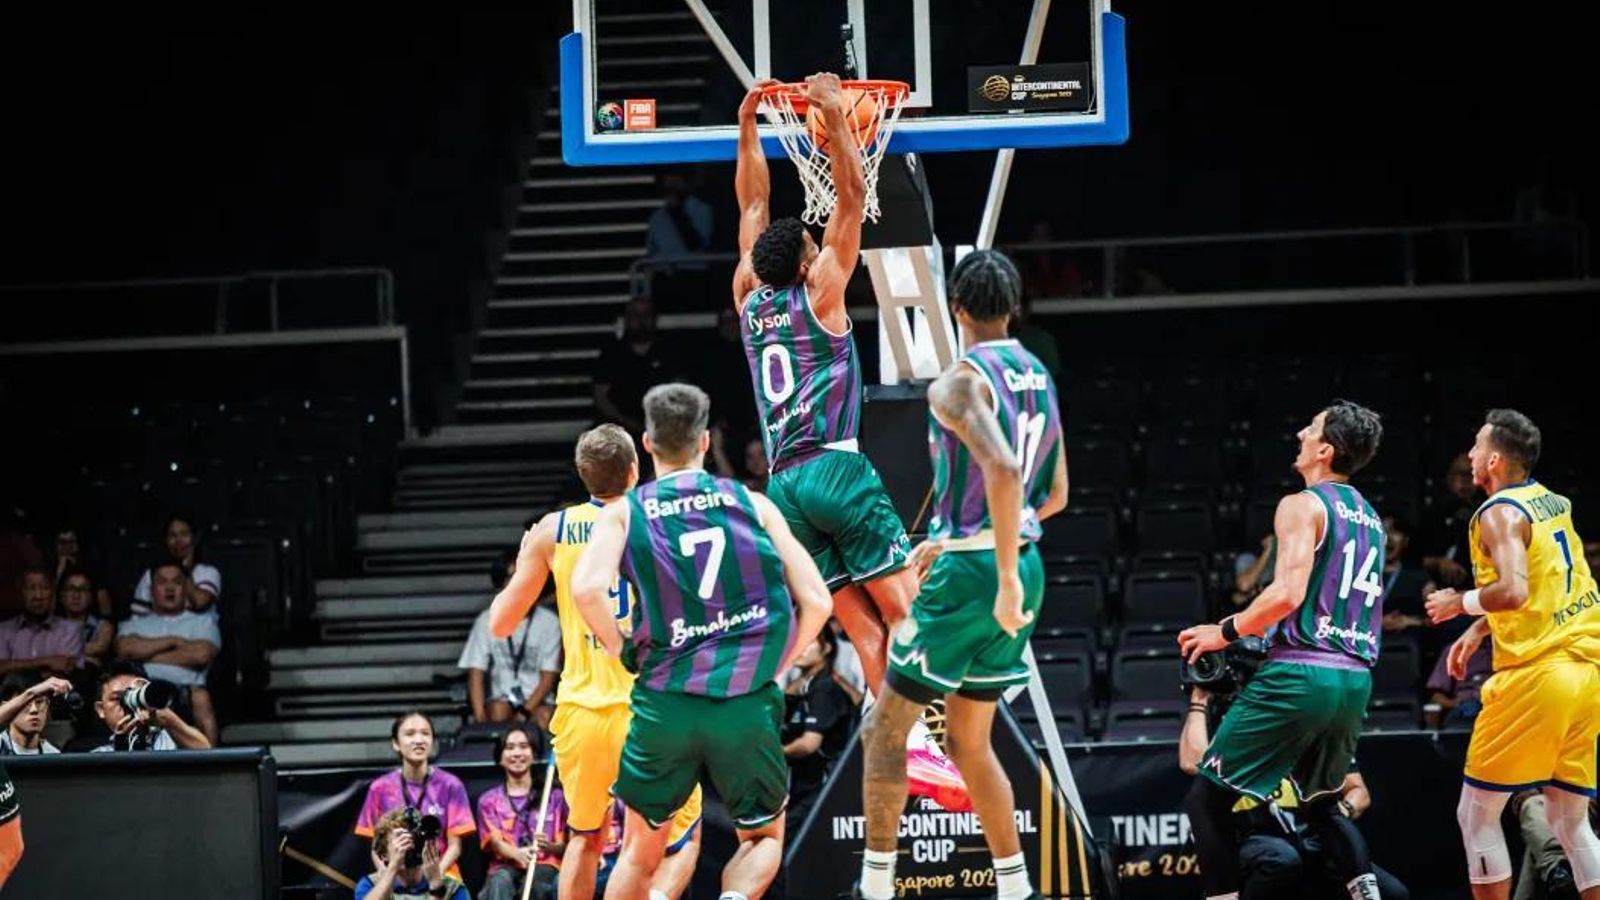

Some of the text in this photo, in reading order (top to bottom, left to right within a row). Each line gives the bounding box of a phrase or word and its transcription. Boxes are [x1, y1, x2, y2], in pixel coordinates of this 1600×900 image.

[630, 103, 651, 114] FIBA
[1011, 91, 1027, 101] CUP
[748, 311, 791, 335] Tyson
[762, 343, 795, 404] 0
[644, 488, 737, 520] Barreiro
[567, 521, 594, 546] KIK
[679, 526, 726, 600] 7
[1338, 538, 1383, 608] 14
[1553, 529, 1574, 595] 1
[832, 809, 1038, 840] INTCONTINEAL
[912, 839, 956, 863] CUP
[895, 867, 996, 898] gapore 202
